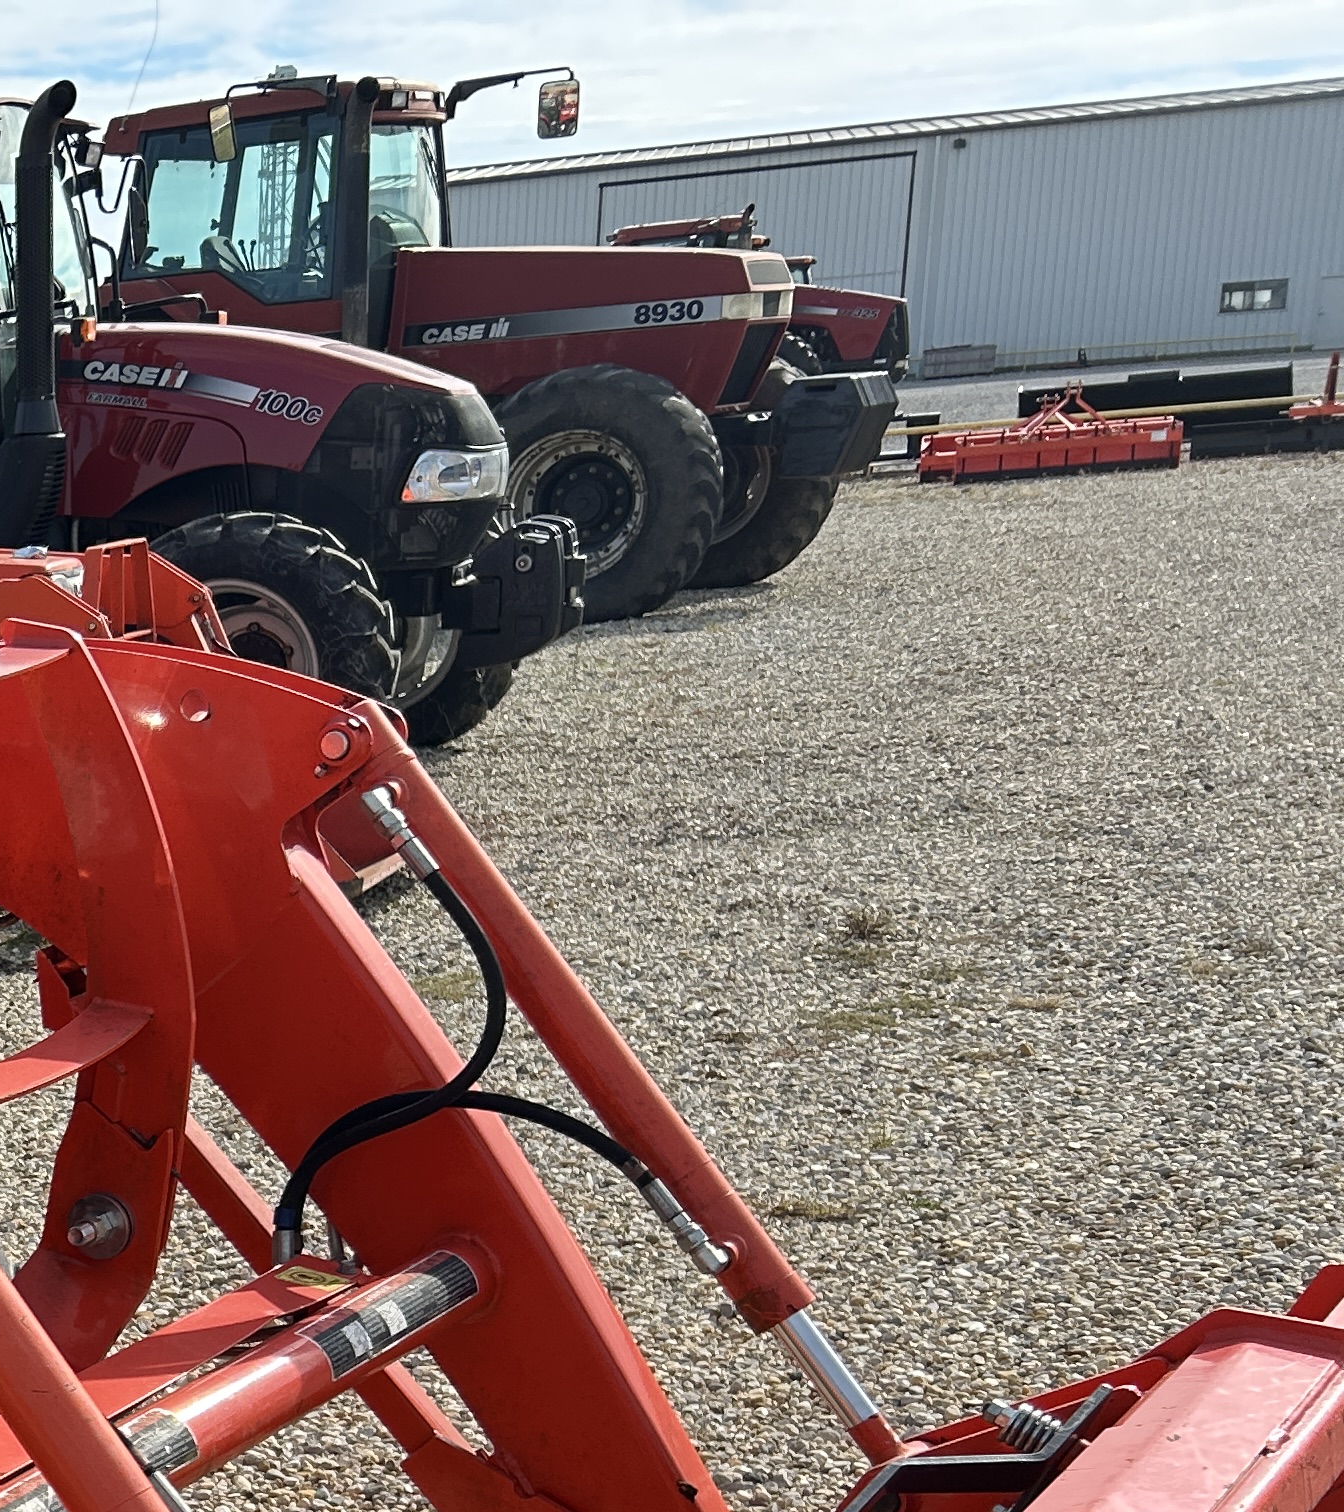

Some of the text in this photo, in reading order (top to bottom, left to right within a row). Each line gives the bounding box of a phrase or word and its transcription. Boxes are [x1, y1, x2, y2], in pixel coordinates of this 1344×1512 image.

[633, 299, 704, 325] 8930
[422, 322, 485, 344] CASE
[85, 392, 148, 408] FARMALL
